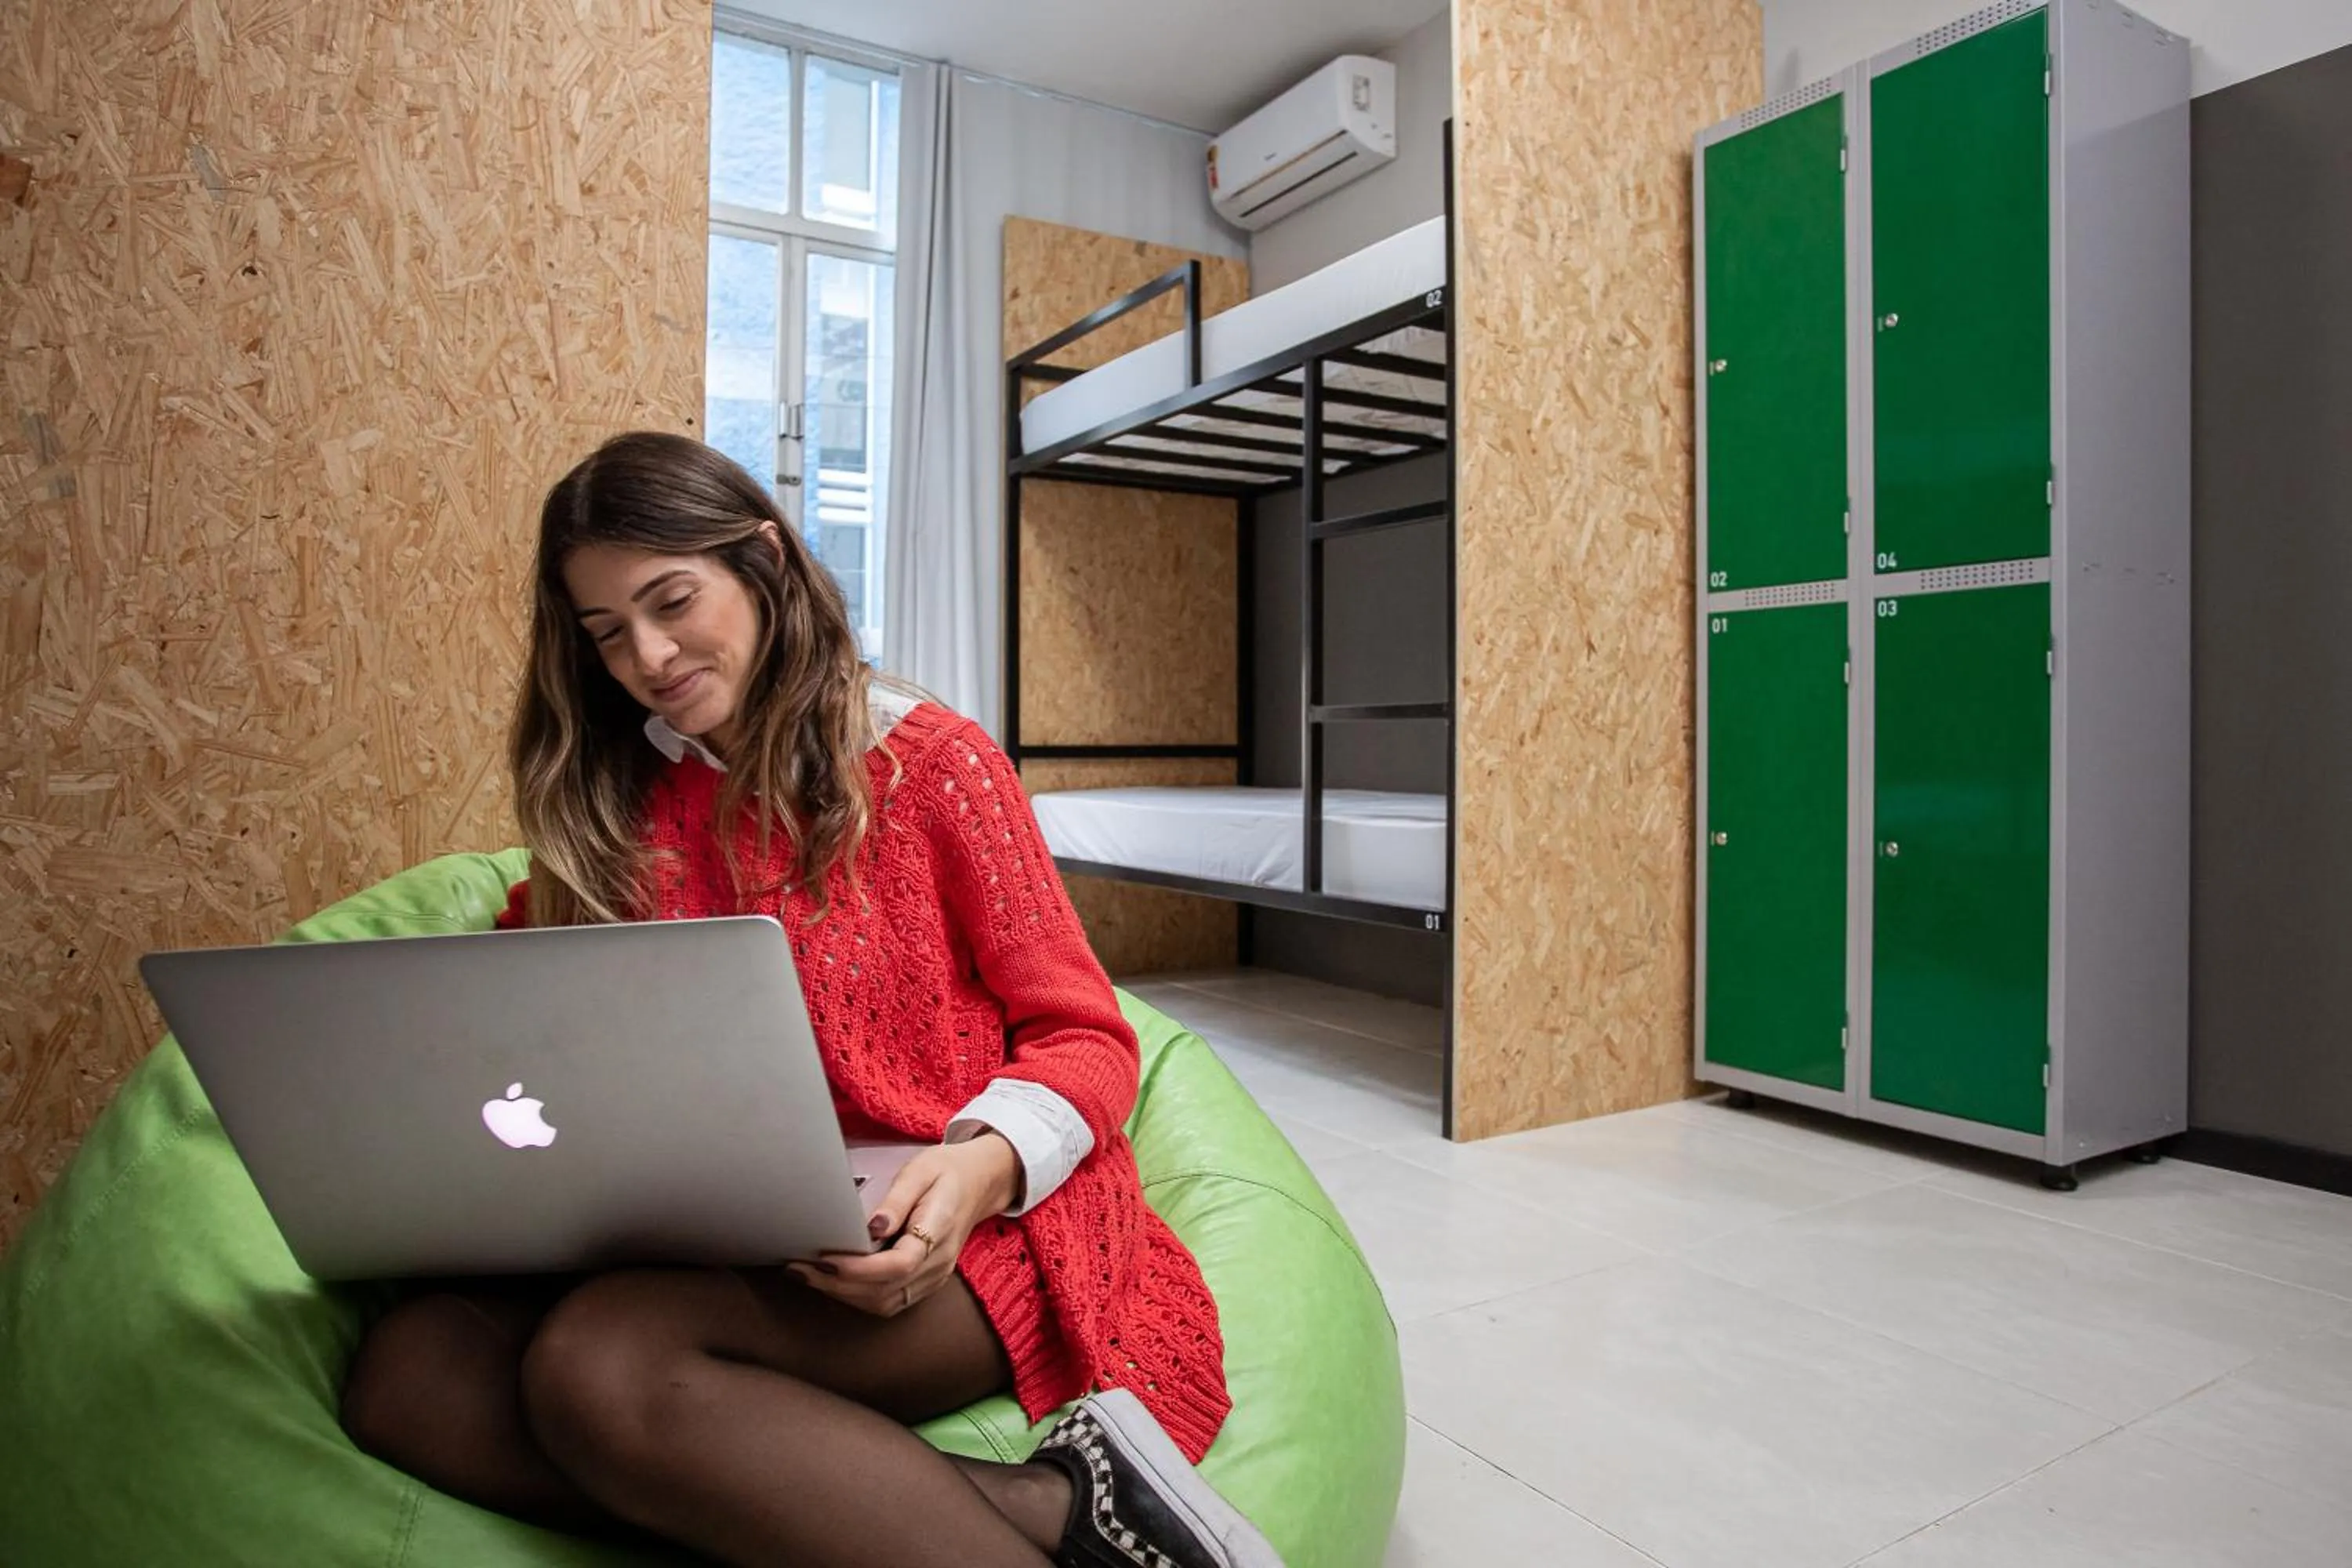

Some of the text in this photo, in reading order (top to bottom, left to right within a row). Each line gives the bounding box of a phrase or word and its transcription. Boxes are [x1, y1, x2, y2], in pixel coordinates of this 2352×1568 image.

[1426, 289, 1443, 307] 02
[1877, 552, 1897, 569] 04
[1710, 572, 1728, 588] 02
[1877, 600, 1897, 617] 03
[1711, 618, 1728, 634] 01
[1425, 913, 1439, 931] 01
